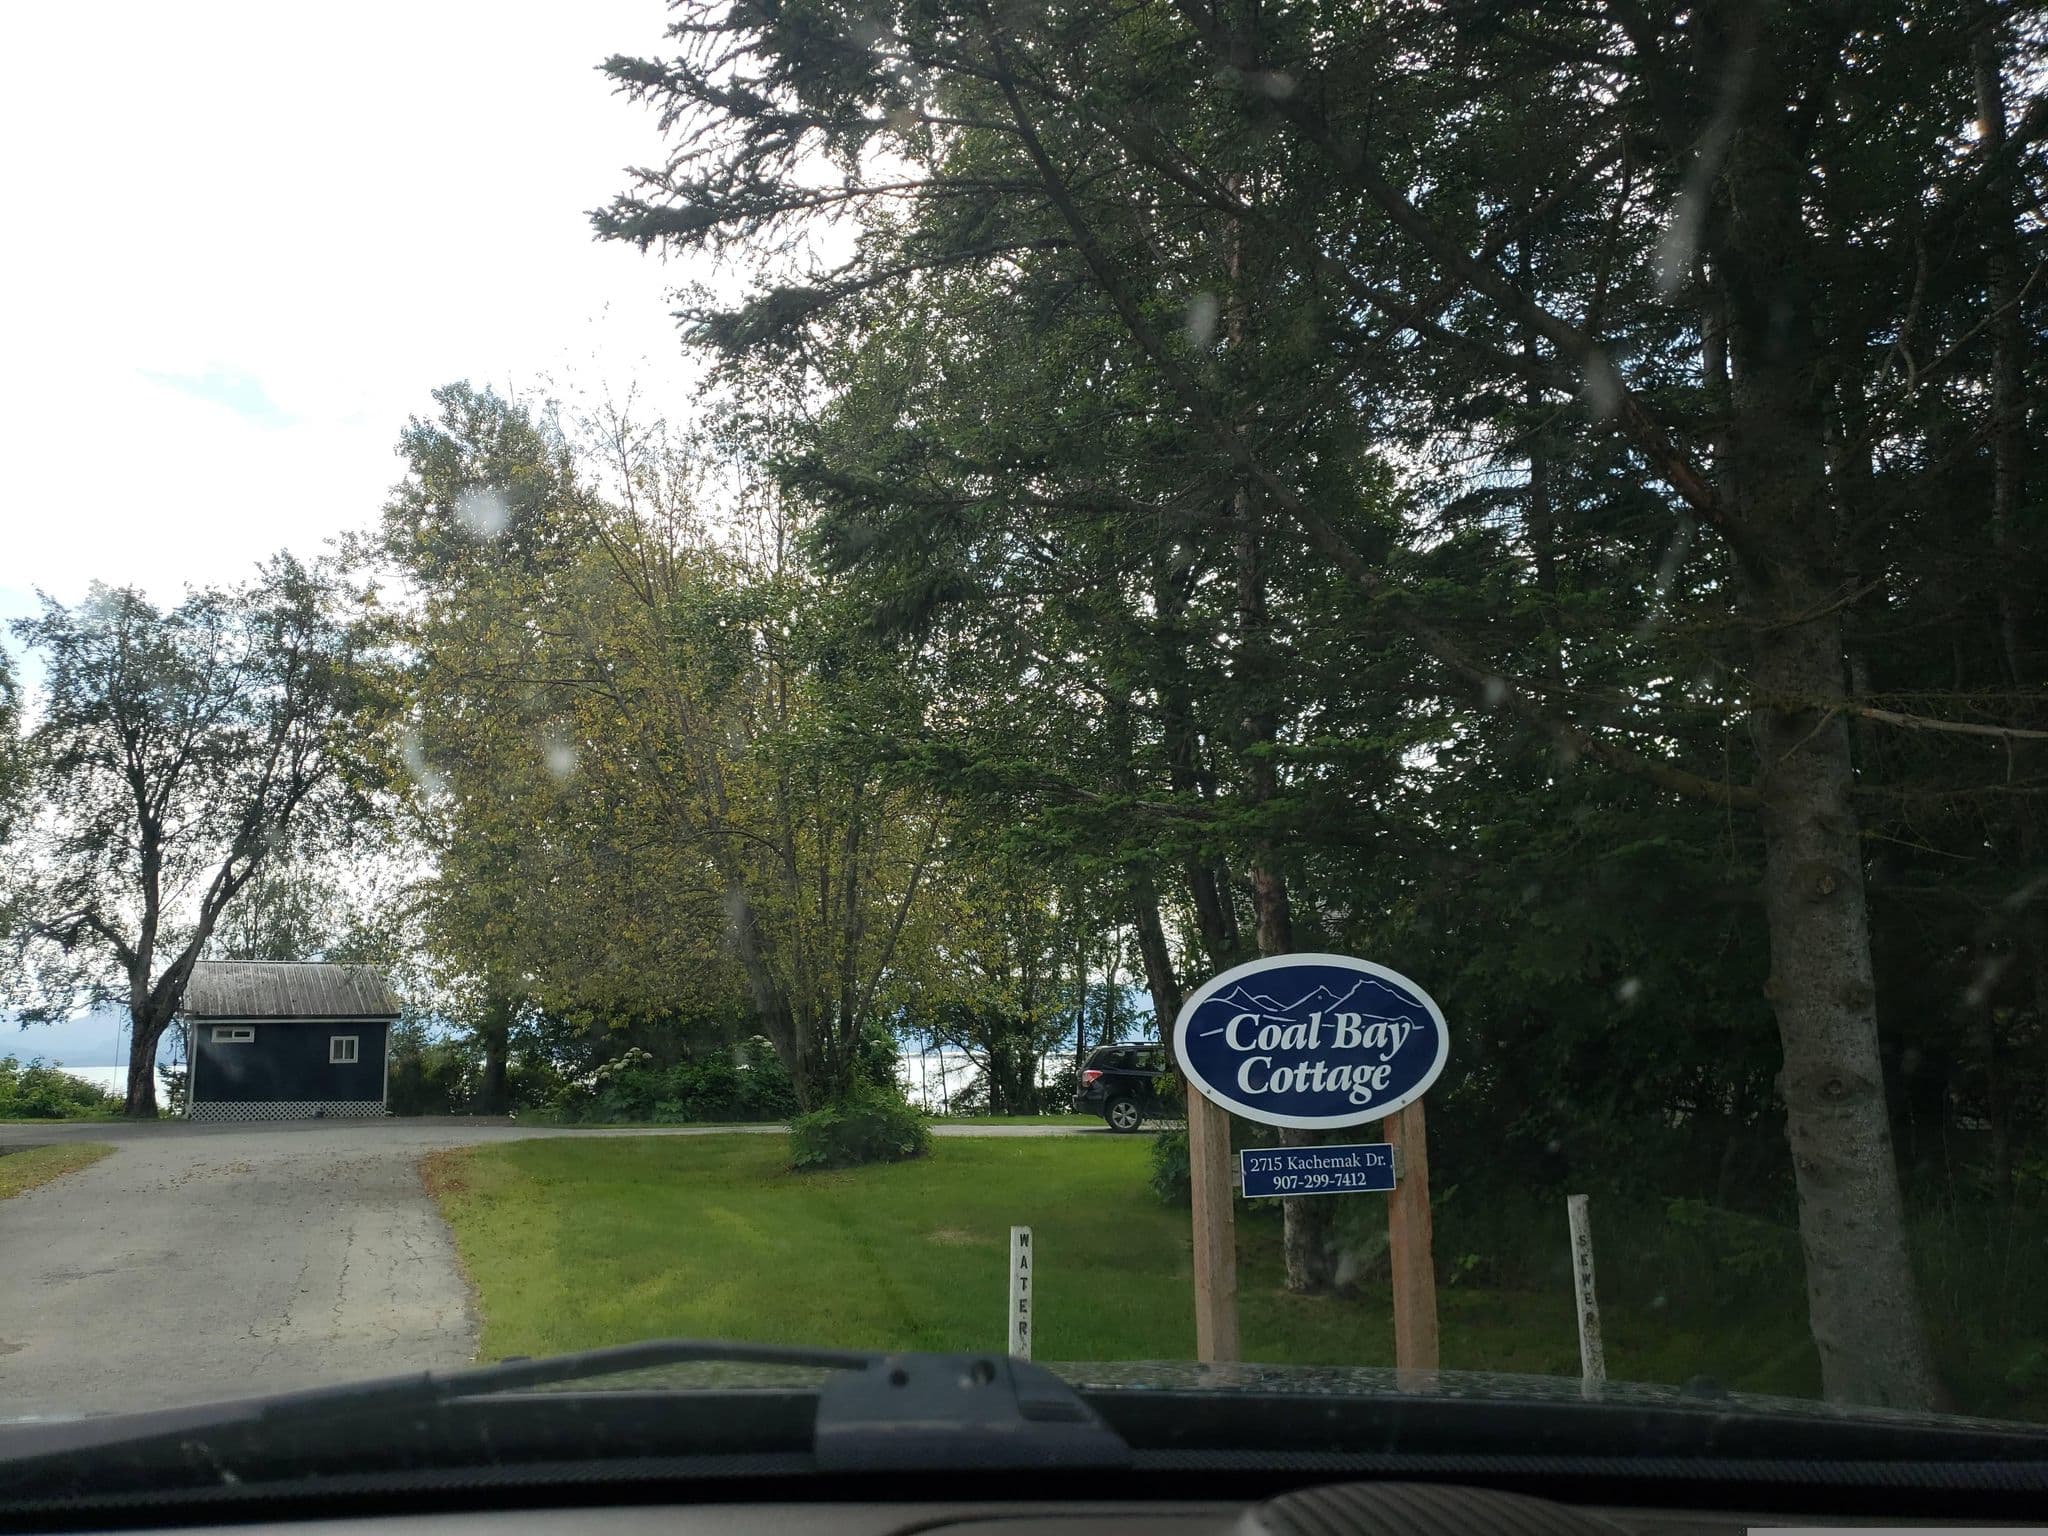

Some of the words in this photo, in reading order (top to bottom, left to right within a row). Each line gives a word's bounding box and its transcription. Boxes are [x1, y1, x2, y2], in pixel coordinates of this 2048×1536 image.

[1225, 1011, 1322, 1051] Coal
[1331, 1013, 1411, 1061] Bay
[1237, 1056, 1392, 1105] Cottage
[1250, 1157, 1282, 1172] 2715
[1287, 1155, 1361, 1171] Kachemak
[1366, 1153, 1387, 1167] Dr.
[1273, 1172, 1367, 1190] 907-299-7412
[1018, 1233, 1030, 1336] WATER
[1578, 1234, 1594, 1326] SEWER
